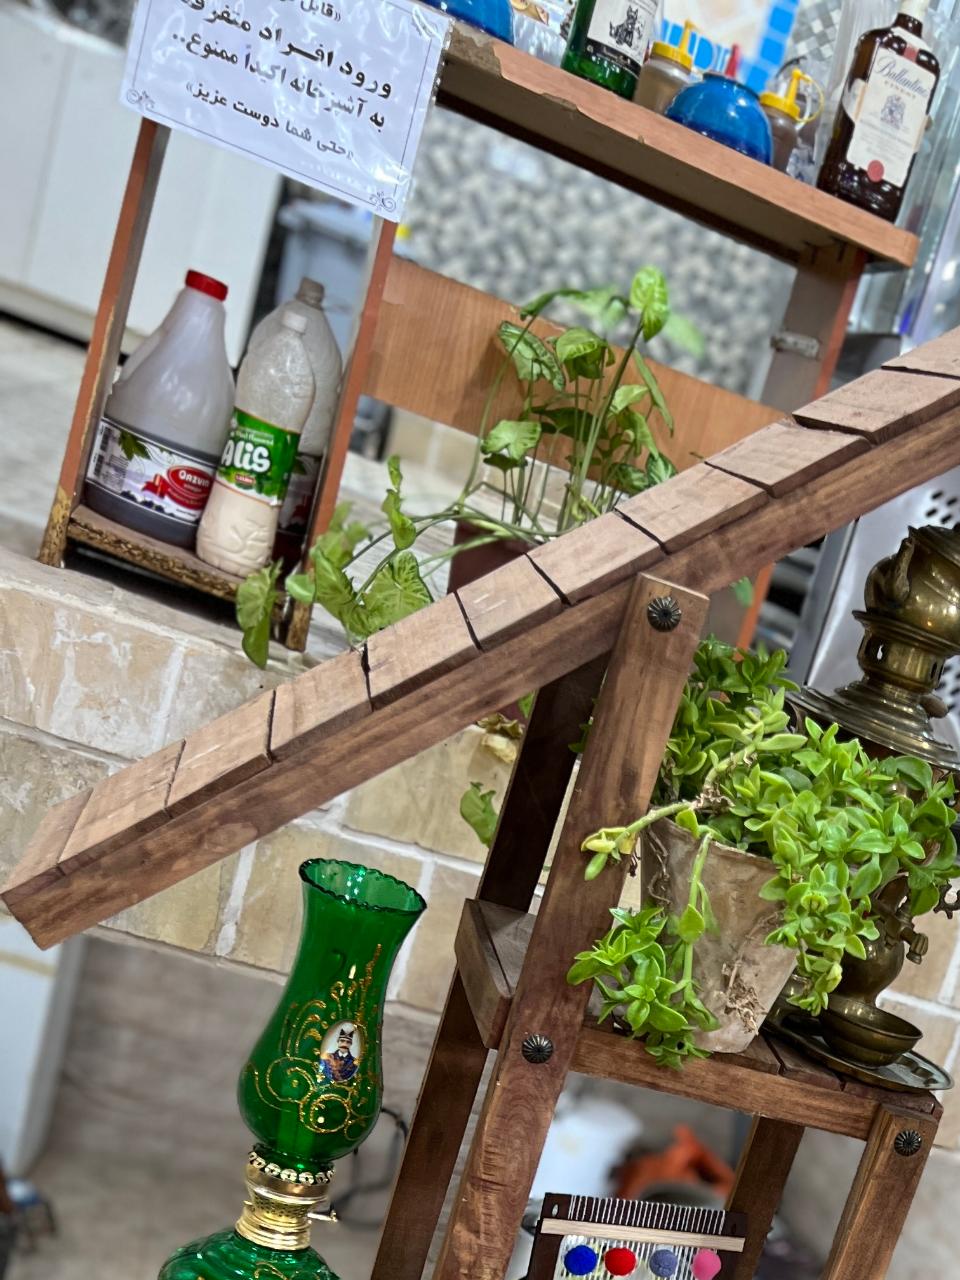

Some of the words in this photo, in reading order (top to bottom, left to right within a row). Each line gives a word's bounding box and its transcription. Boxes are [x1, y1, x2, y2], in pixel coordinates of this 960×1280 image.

[340, 61, 392, 99] ورود
[232, 100, 279, 129] دوست
[369, 111, 386, 133] به
[285, 119, 312, 141] شما
